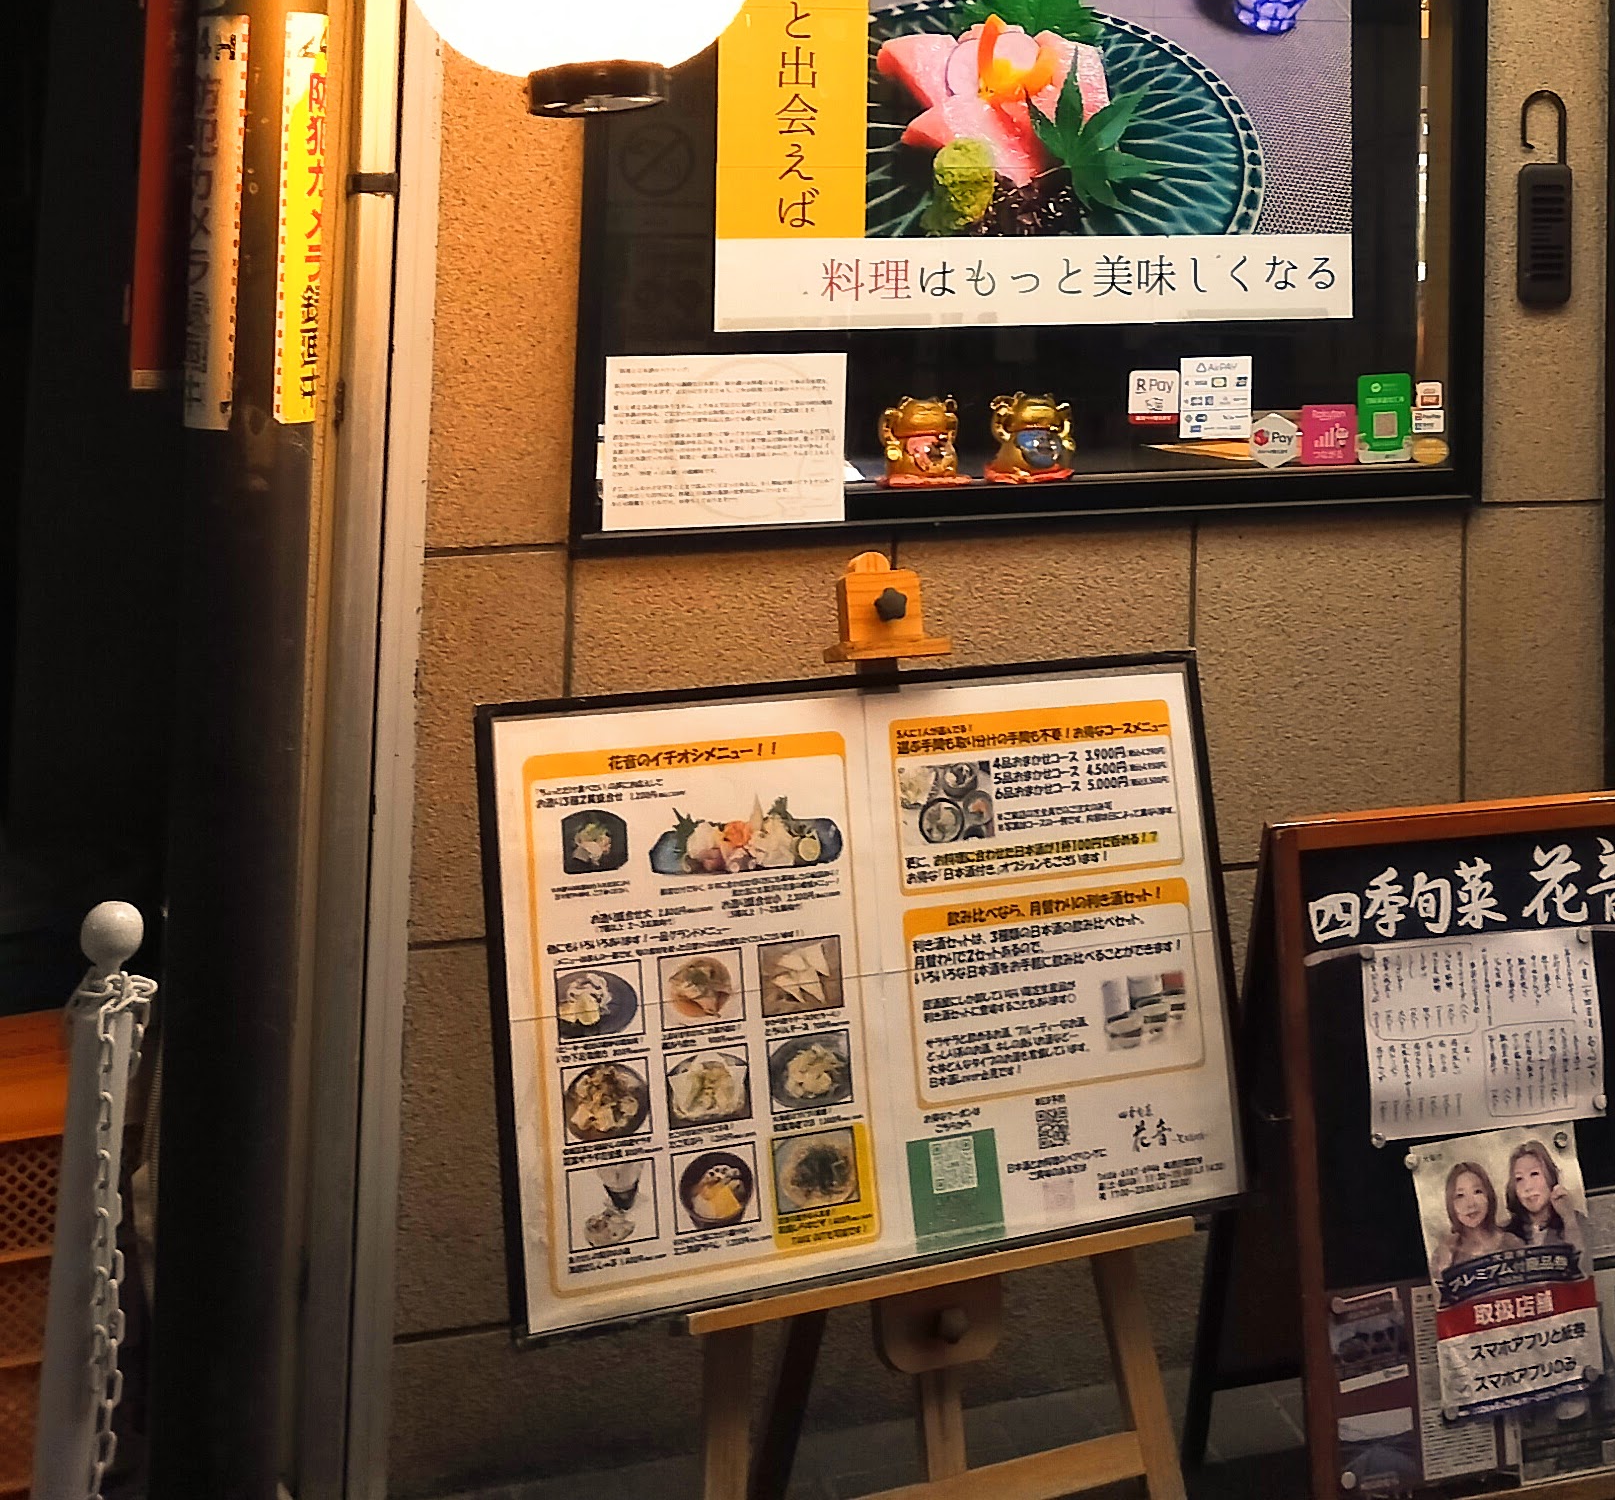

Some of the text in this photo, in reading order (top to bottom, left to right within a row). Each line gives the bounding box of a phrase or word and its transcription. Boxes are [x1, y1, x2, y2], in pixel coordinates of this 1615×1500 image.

[820, 252, 1338, 302] 料理はもっと美味しくなる
[1149, 378, 1174, 393] Pay
[1271, 431, 1294, 446] Pay
[1308, 856, 1507, 943] 四季旬菜
[1472, 1289, 1555, 1326] 取扱店舗
[1474, 1356, 1577, 1392] スマホアプリのみ
